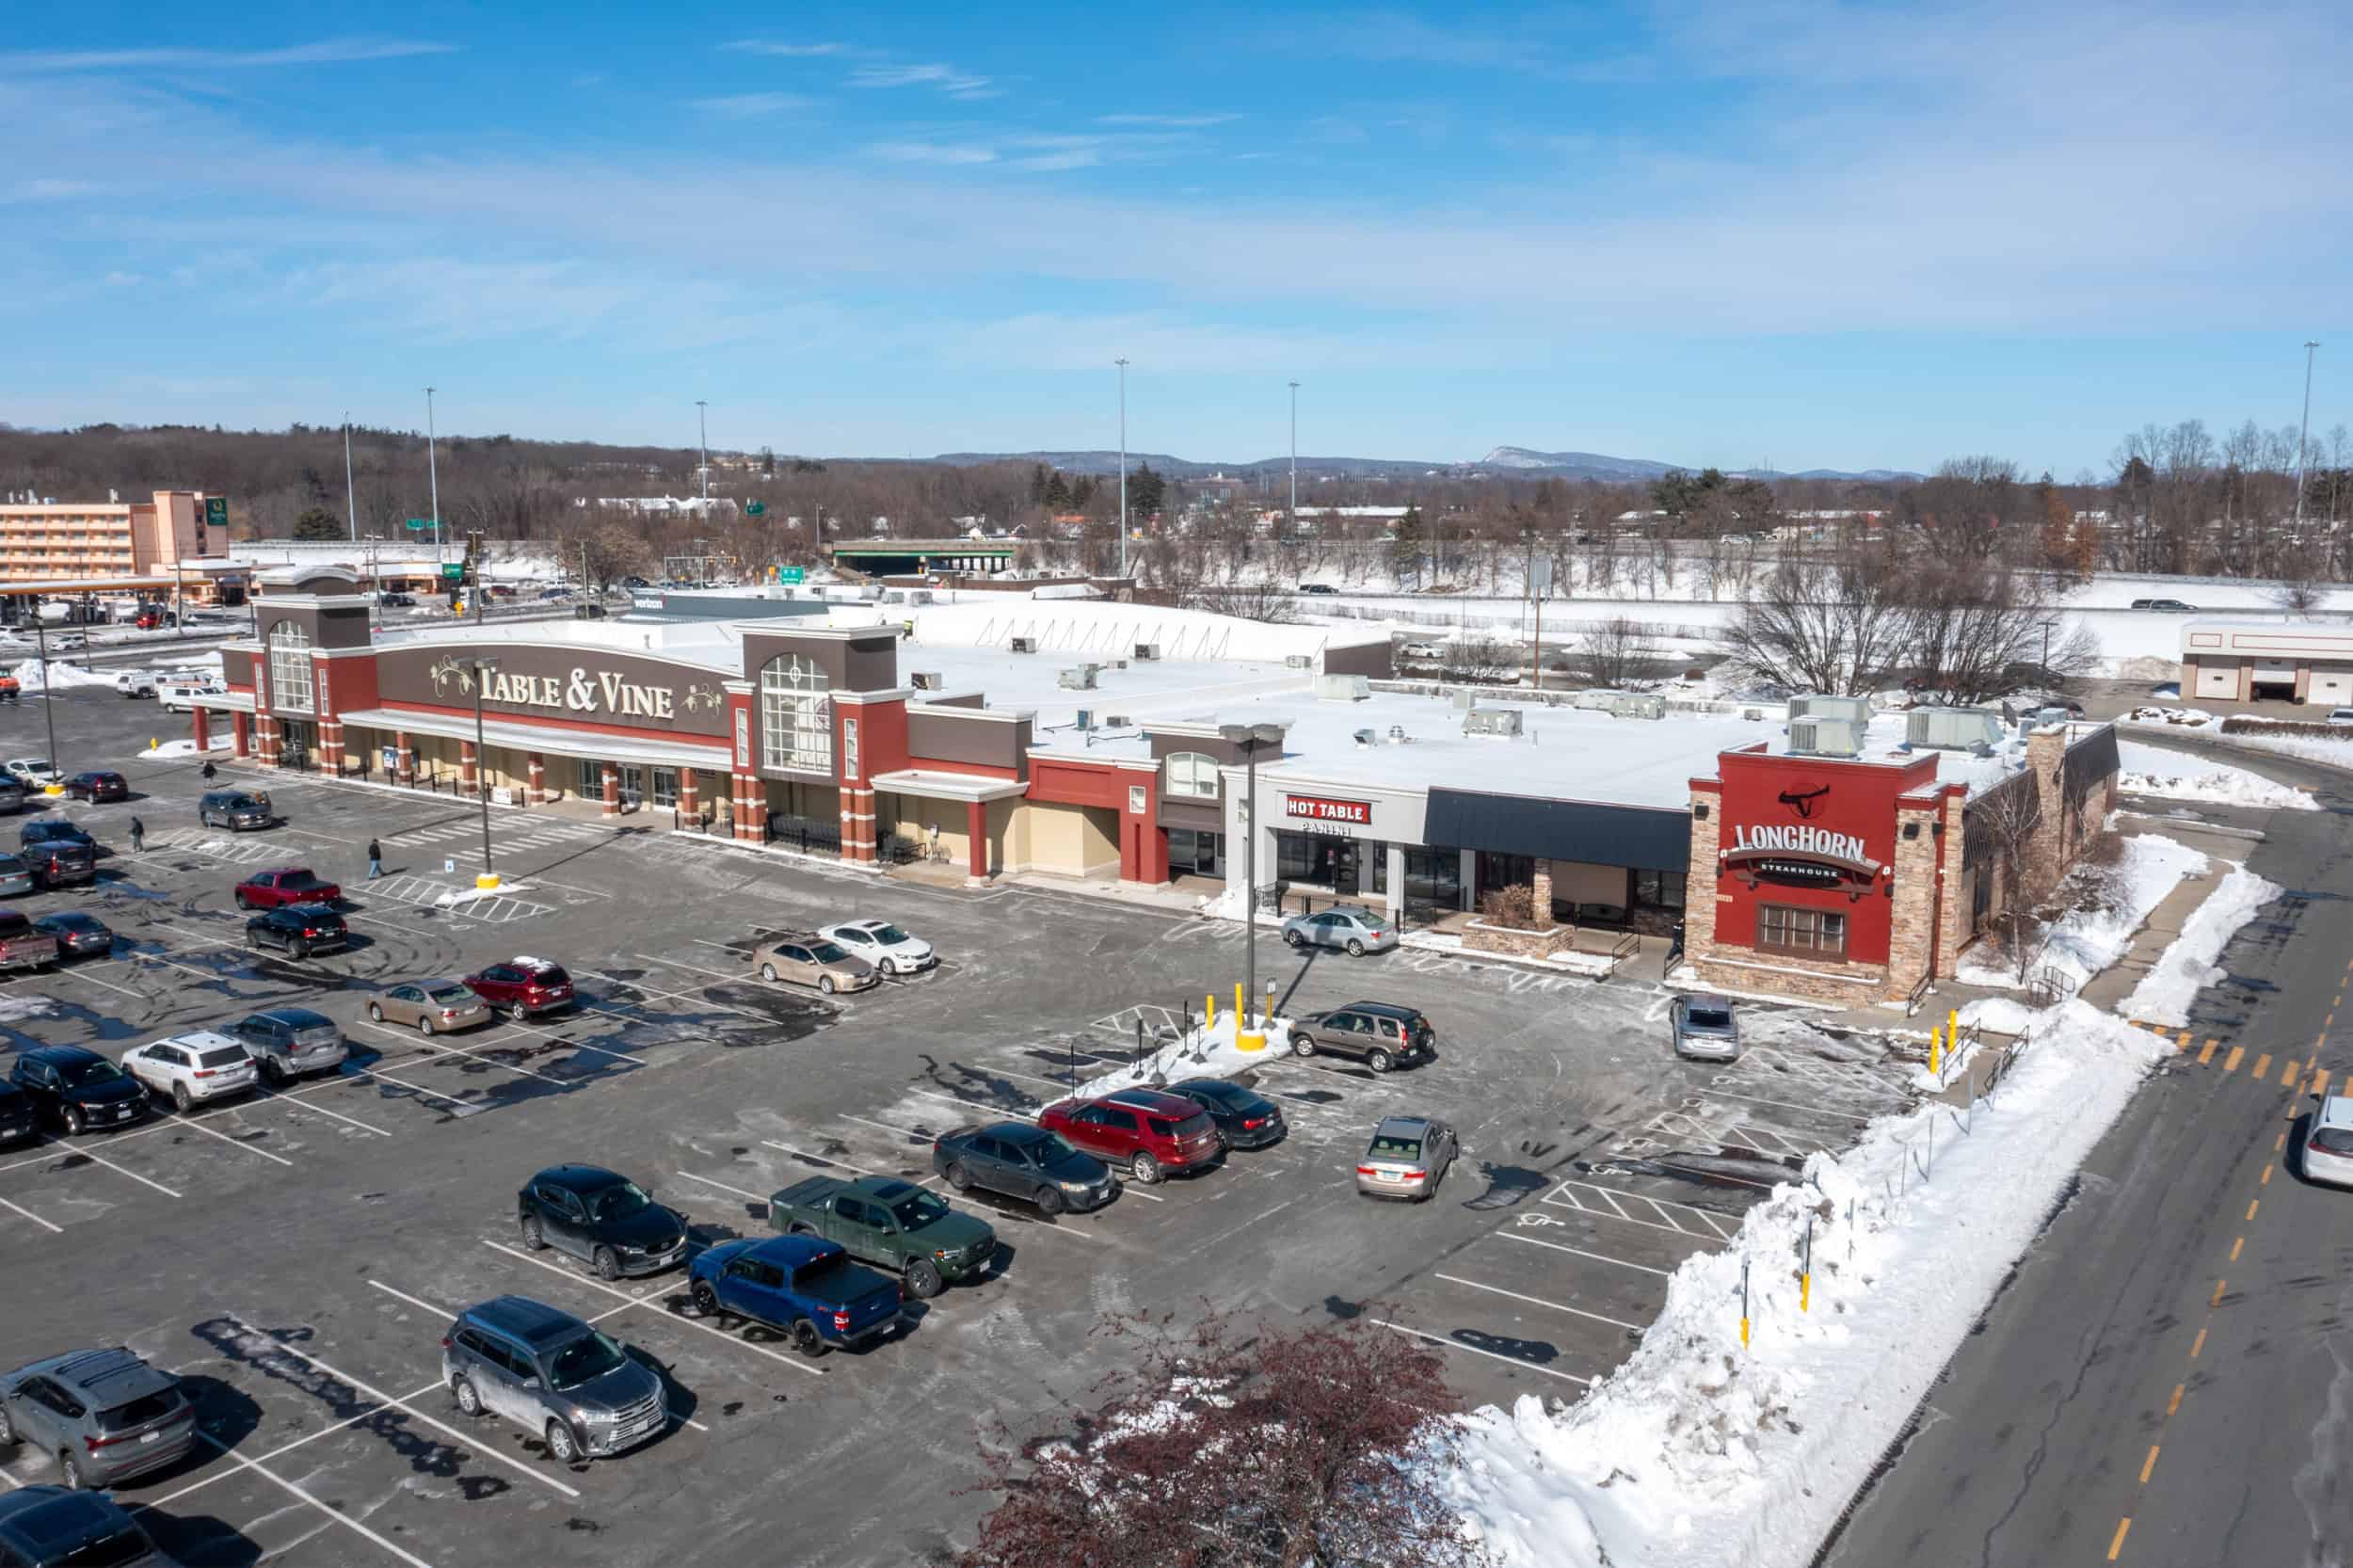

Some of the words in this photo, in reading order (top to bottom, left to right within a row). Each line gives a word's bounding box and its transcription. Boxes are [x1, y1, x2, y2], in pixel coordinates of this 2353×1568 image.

[478, 665, 562, 708] TABLE
[566, 667, 599, 712] &
[598, 671, 675, 719] VINE
[1288, 800, 1316, 815] HOT
[1319, 803, 1364, 821] TABLE
[1302, 821, 1352, 837] PANINI
[1735, 824, 1865, 862] LONGHORN
[1761, 863, 1838, 878] STEAKHOUSE
